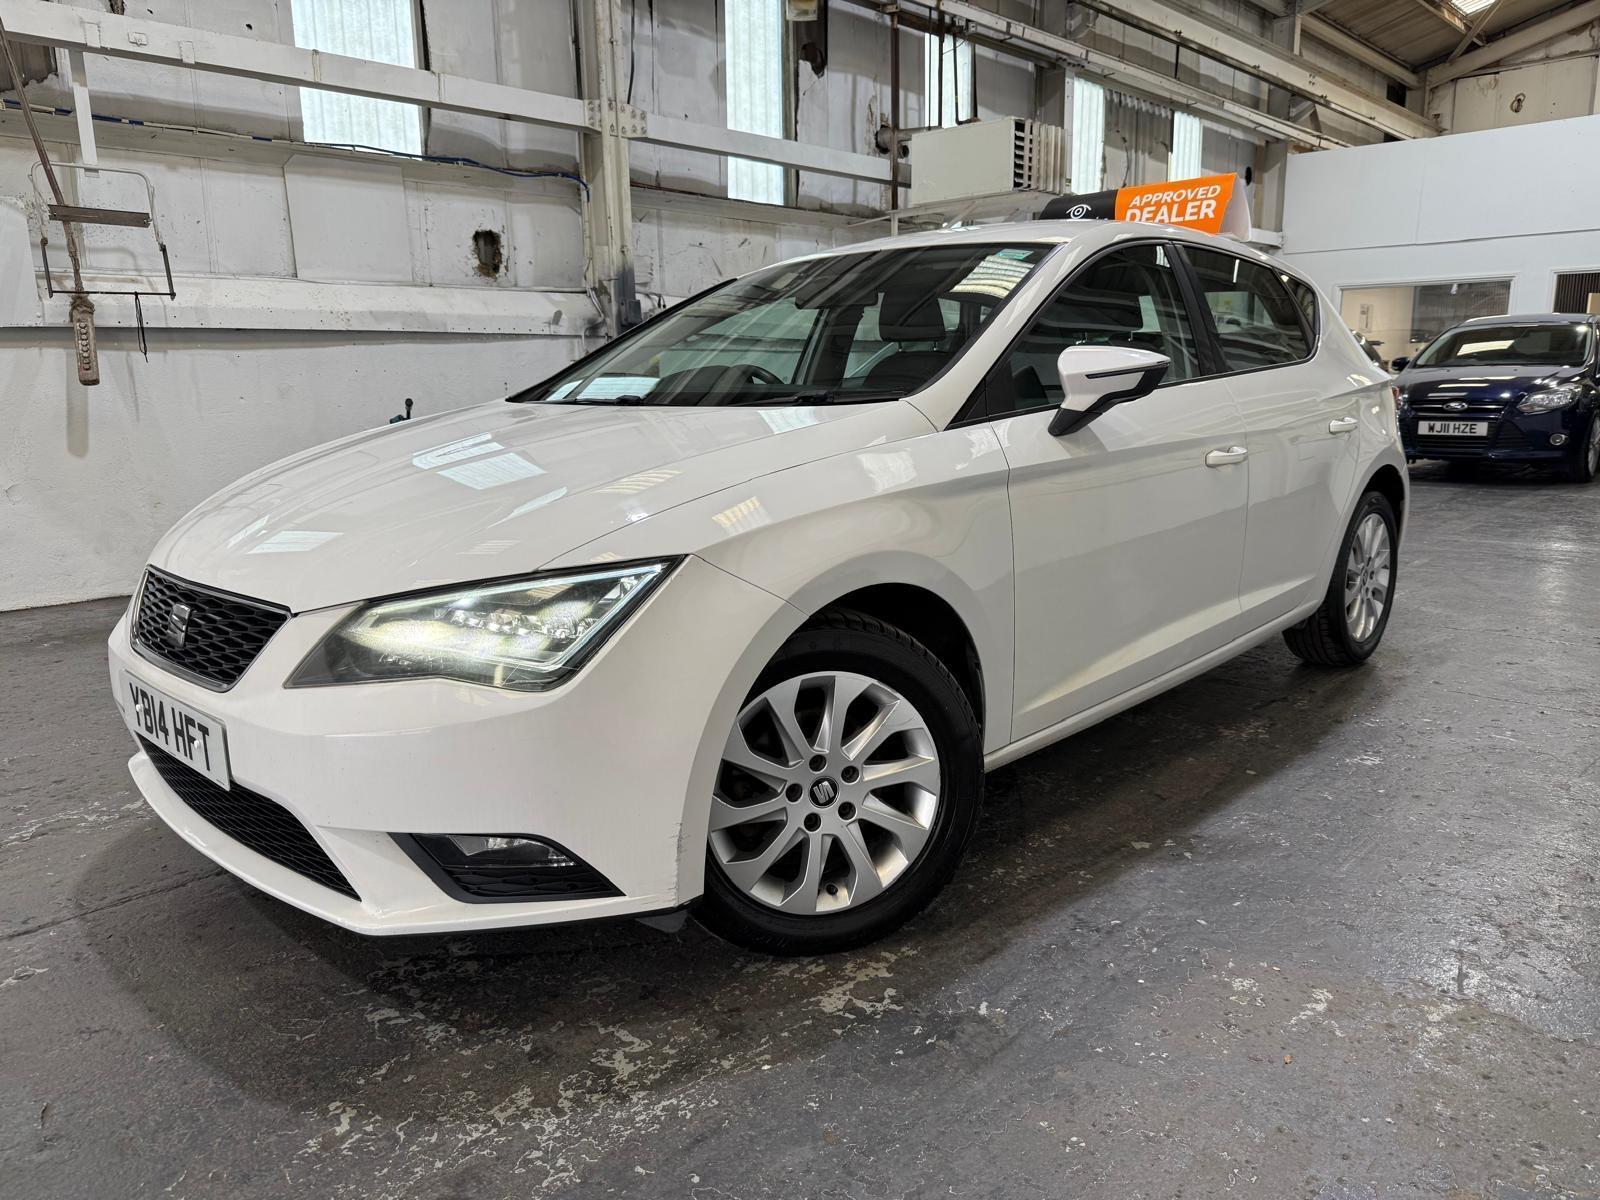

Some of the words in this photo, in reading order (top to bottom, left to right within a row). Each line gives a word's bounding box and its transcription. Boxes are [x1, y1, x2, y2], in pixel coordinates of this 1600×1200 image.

[1129, 184, 1221, 208] APPROVED
[1125, 199, 1217, 223] DEALER
[1428, 423, 1450, 433] WJ11
[1453, 423, 1477, 434] HZE
[129, 682, 169, 745] YB14
[171, 706, 210, 772] HFT
